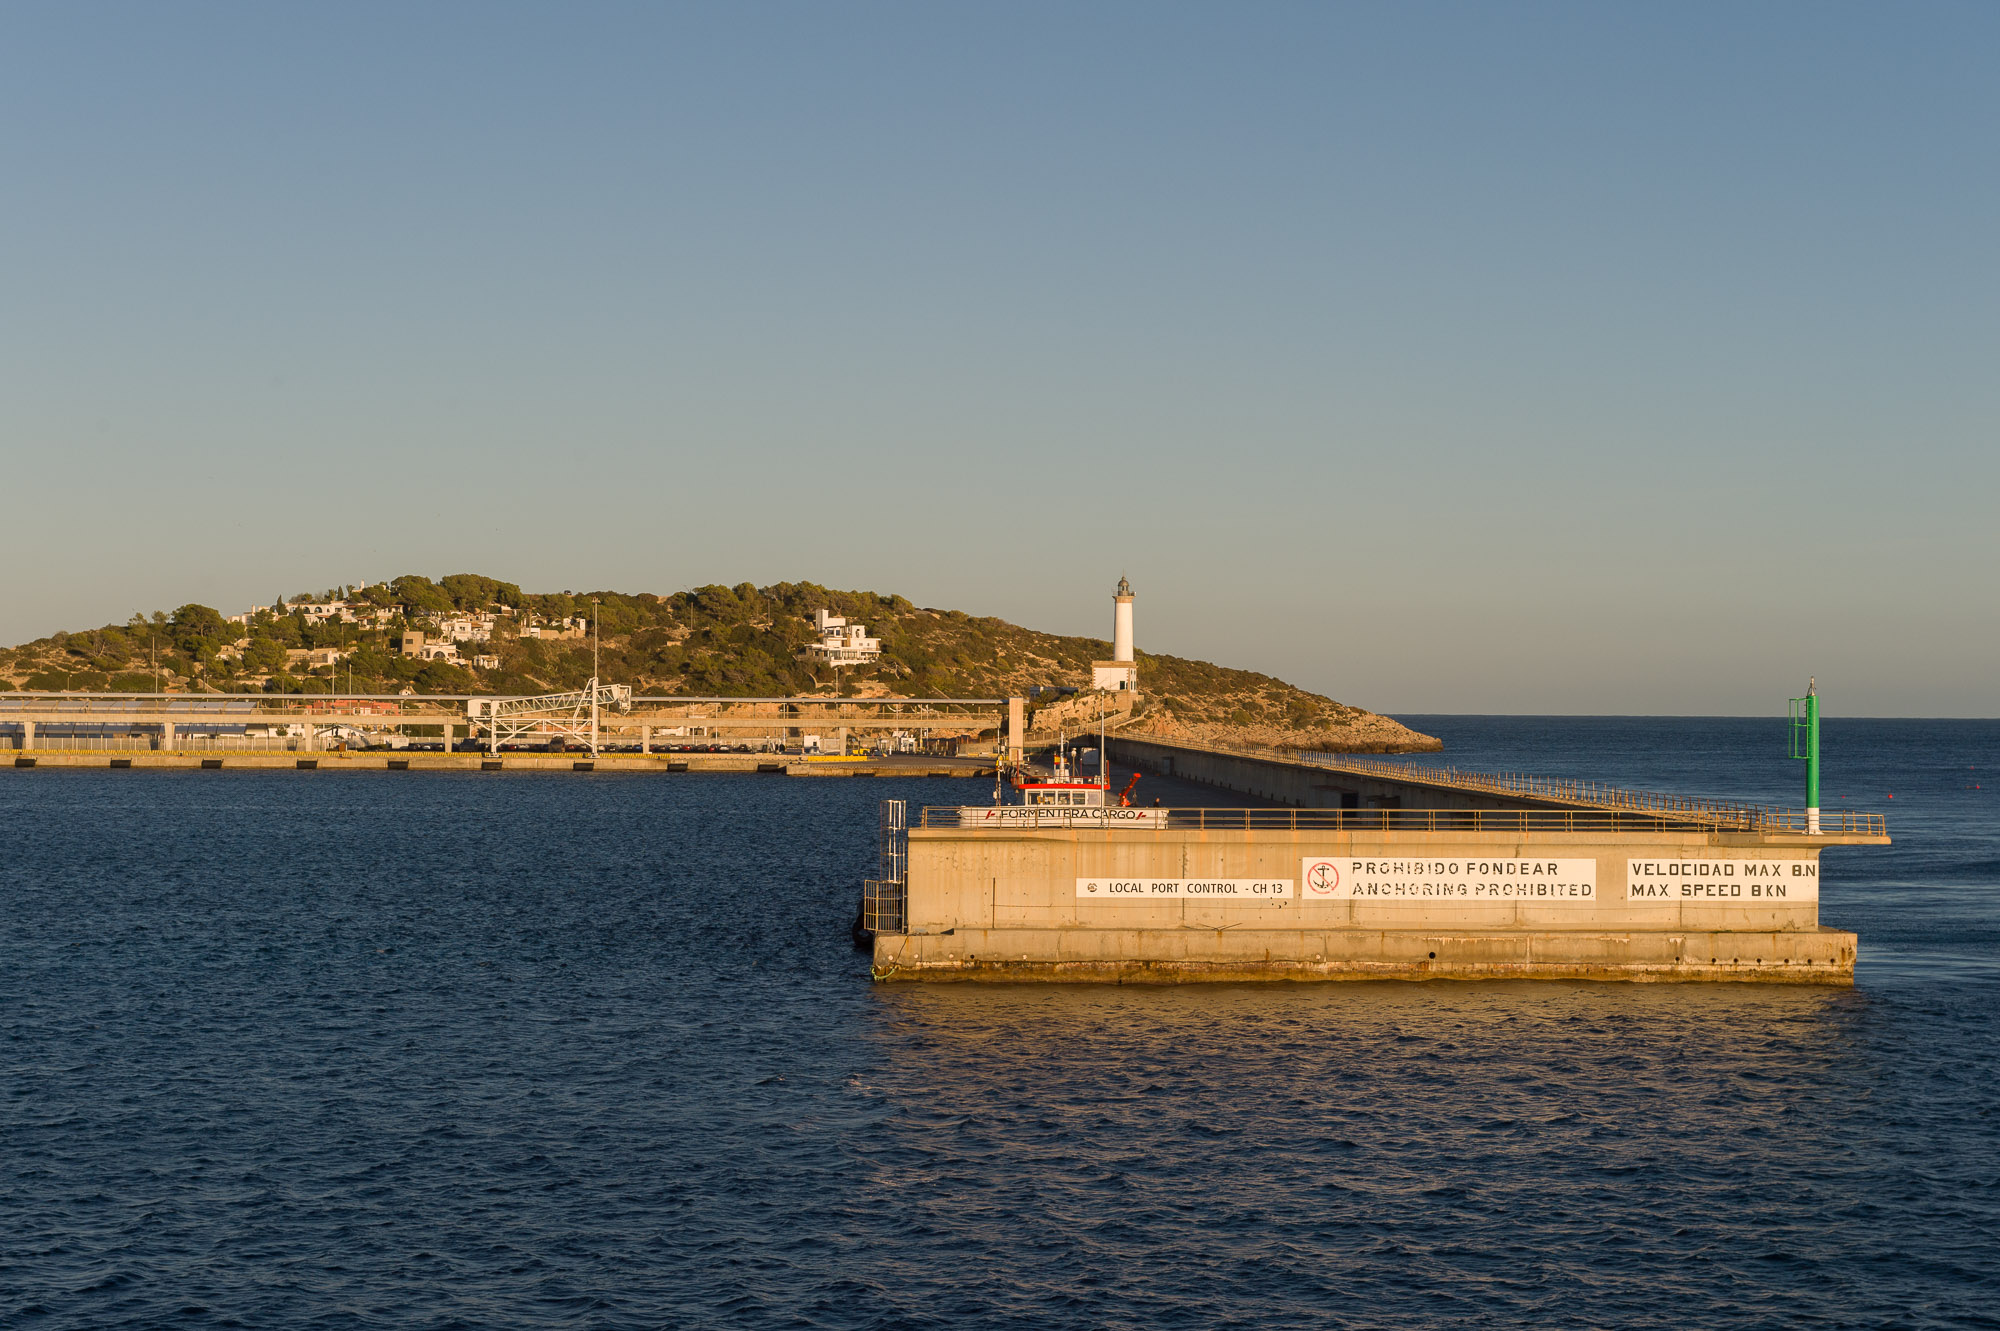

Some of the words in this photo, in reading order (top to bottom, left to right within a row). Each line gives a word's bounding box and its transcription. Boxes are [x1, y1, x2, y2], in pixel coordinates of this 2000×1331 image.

[1001, 809, 1089, 819] FORMENTERA
[1091, 809, 1136, 819] CARGO
[1352, 862, 1459, 875] PROHIBIDO
[1466, 862, 1558, 876] FONDEAR
[1632, 863, 1734, 876] VELOCIDAD
[1744, 864, 1781, 876] MAX
[1109, 882, 1144, 893] LOCAL
[1151, 883, 1180, 893] PORT
[1187, 883, 1238, 894] CONTROL
[1252, 884, 1267, 894] CH
[1271, 884, 1283, 894] 13
[1352, 882, 1468, 896] ANCHORING
[1475, 883, 1592, 897] PROHIBITED
[1681, 884, 1741, 897] SPEED
